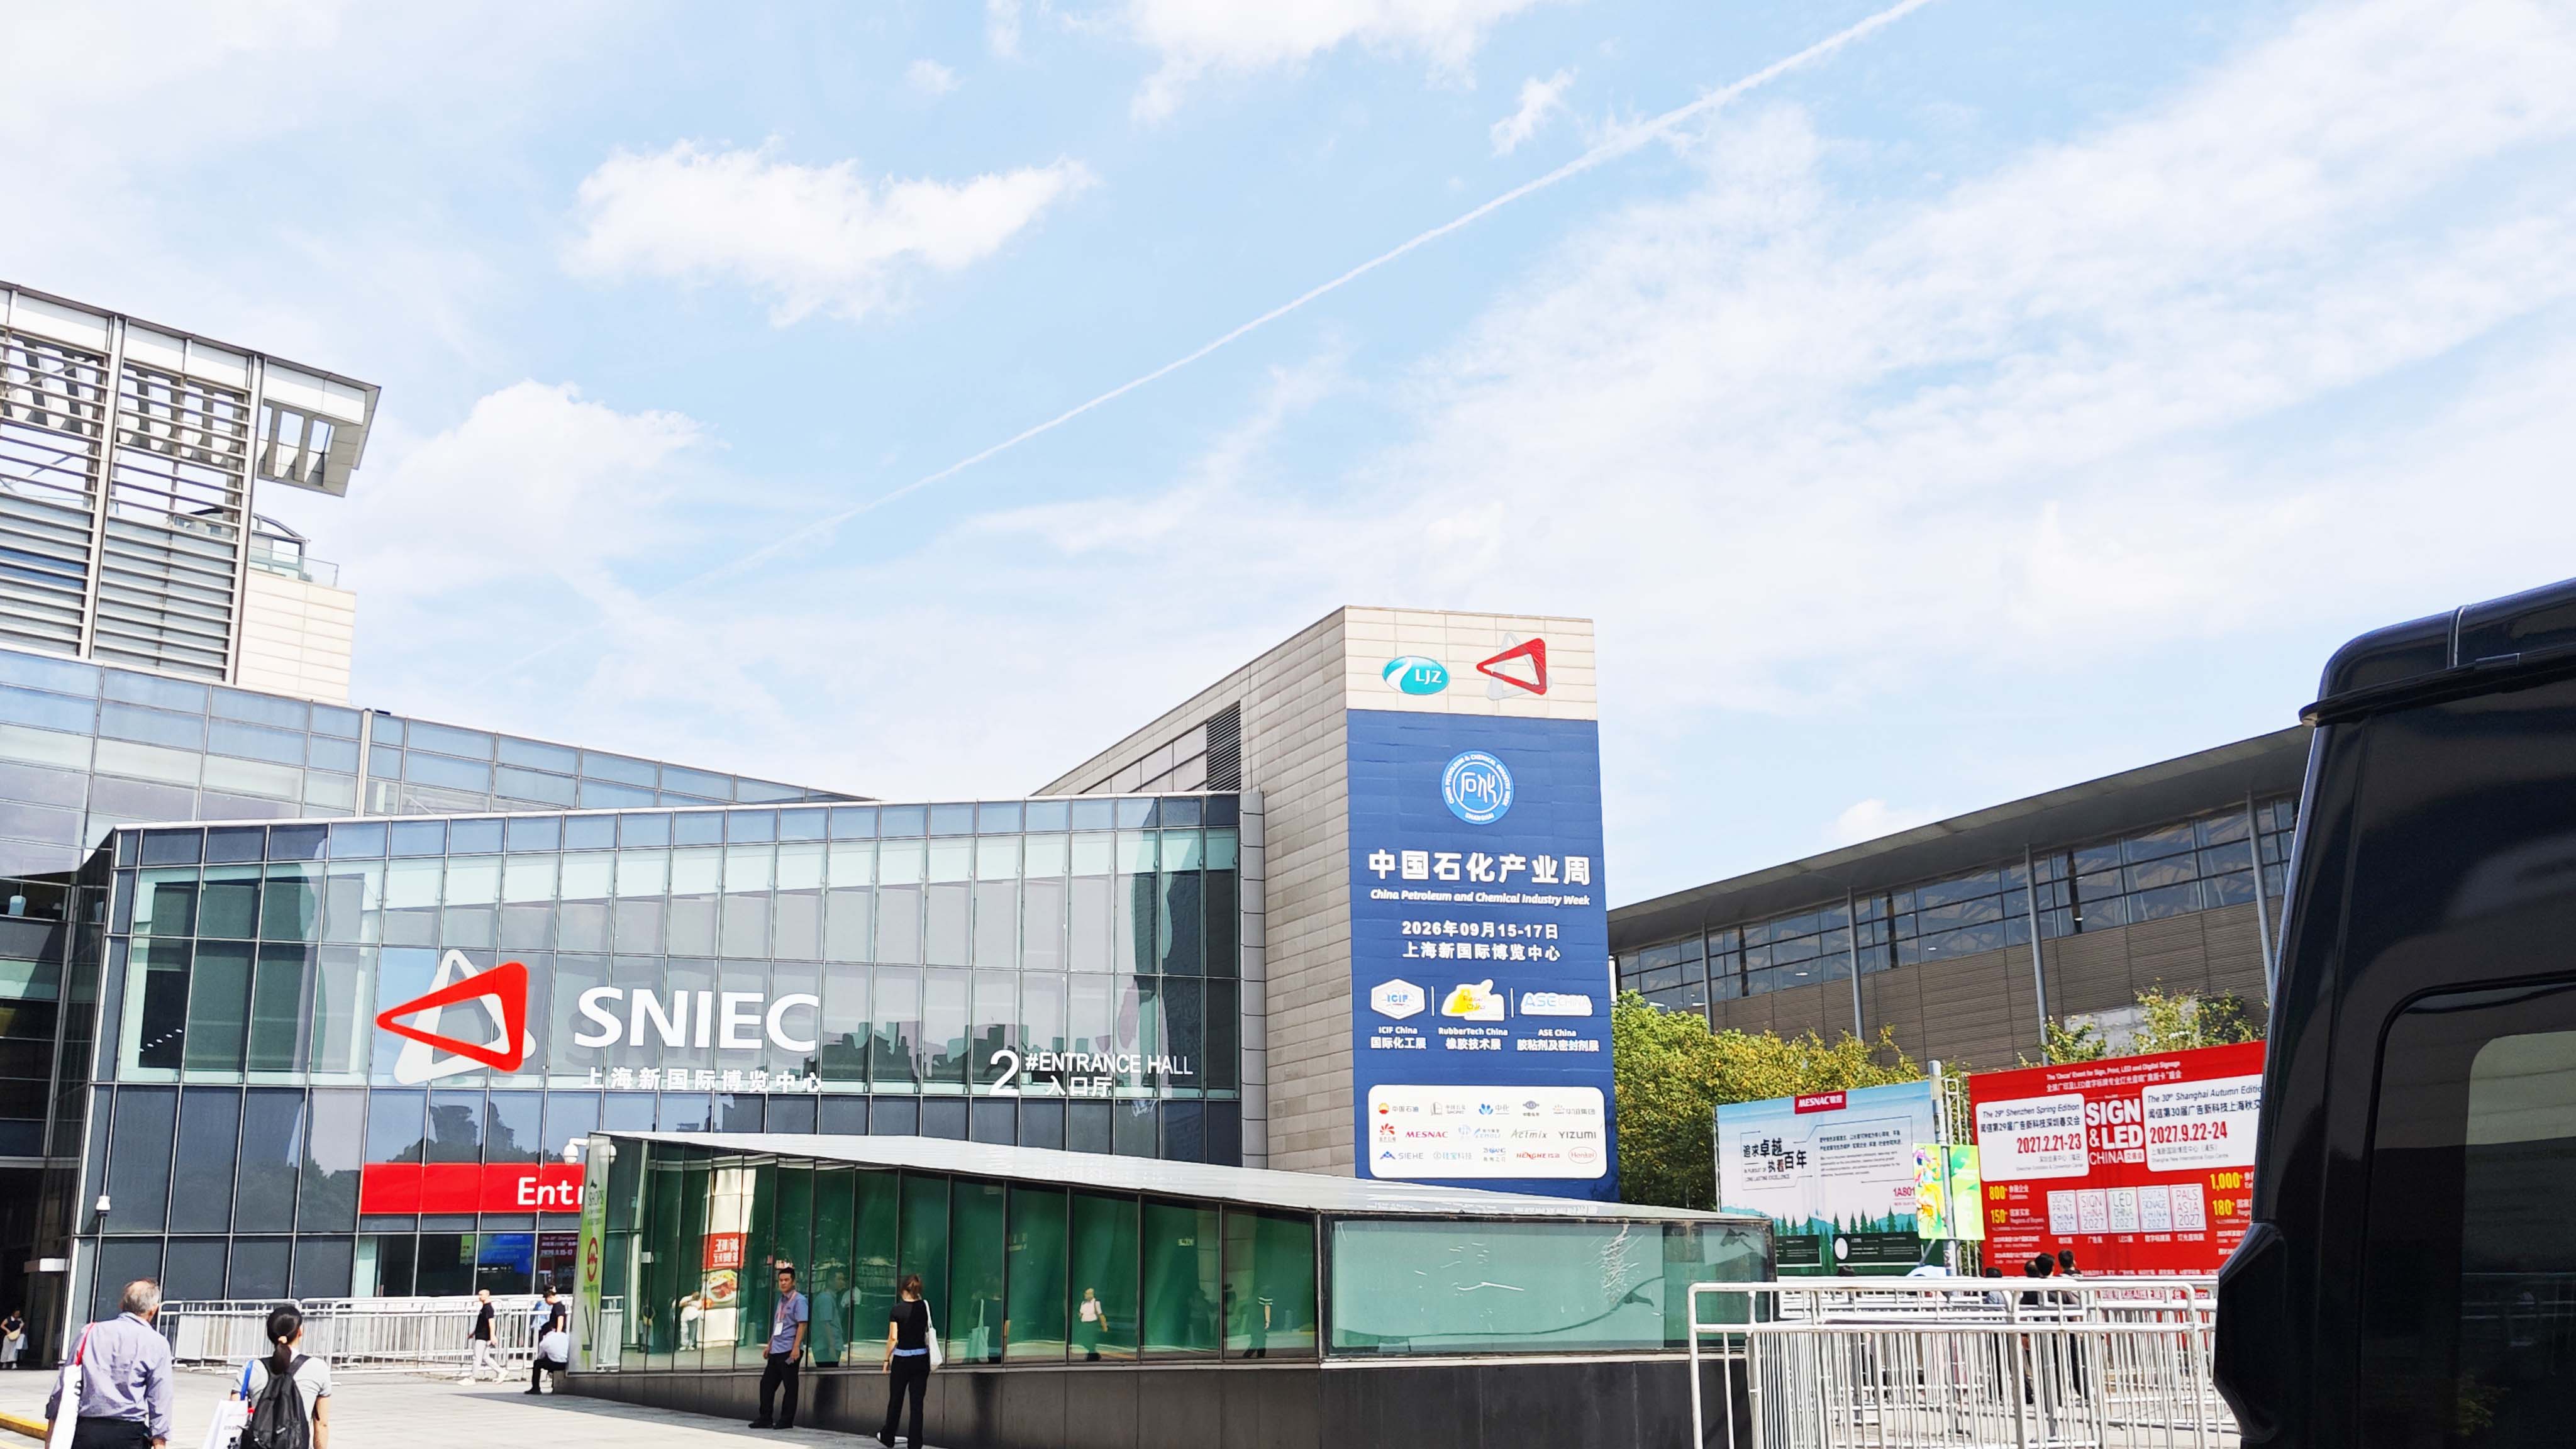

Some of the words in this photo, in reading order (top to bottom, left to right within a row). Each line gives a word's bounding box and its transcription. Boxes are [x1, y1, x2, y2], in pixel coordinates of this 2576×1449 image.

[1415, 669, 1442, 684] LJZ
[1368, 848, 1591, 886] 中国石化产业周
[1370, 889, 1399, 899] China
[1401, 890, 1452, 901] Petroleum
[1453, 891, 1474, 902] and
[1475, 892, 1521, 903] Chemical
[1522, 894, 1562, 906] Industry
[1563, 894, 1591, 906] Week
[1402, 920, 1558, 940] 2026年09月15-17日
[1402, 941, 1561, 961] 上海新国际博览中心
[574, 986, 819, 1052] SNIEC
[1395, 1026, 1418, 1035] China
[1438, 1027, 1484, 1035] RubberTech
[1555, 1029, 1577, 1037] China
[1370, 1036, 1426, 1049] 国际化工展
[1446, 1038, 1501, 1050] 橡胶技术展
[1148, 1055, 1194, 1075] HALL
[583, 1066, 823, 1093] 上海新国际博览中心
[1046, 1075, 1113, 1097] 入口厅
[1798, 1097, 1829, 1108] MESNAC
[2148, 1095, 2159, 1103] The
[2176, 1089, 2209, 1101] Shanghai
[2211, 1087, 2239, 1097] Autumn
[2006, 1107, 2035, 1116] Shenzhen
[2036, 1105, 2057, 1114] Spring
[2058, 1103, 2080, 1112] Edition
[2085, 1098, 2141, 1126] SIGN
[2089, 1128, 2100, 1148] &
[2101, 1124, 2144, 1150] LED
[2150, 1121, 2228, 1144] 2027.9.22-24
[2017, 1133, 2082, 1154] 2027.2.21-23
[2089, 1150, 2124, 1165] CHINA
[2080, 1195, 2102, 1208] SIGN
[2113, 1192, 2133, 1207] LED
[2176, 1189, 2198, 1201] PALS
[2114, 1208, 2133, 1218] CHINA
[2177, 1202, 2199, 1214] ASIA
[2084, 1218, 2104, 1230] 2027
[2115, 1218, 2135, 1228] 2027
[2148, 1219, 2165, 1228] 2027
[2179, 1214, 2200, 1226] 2027
